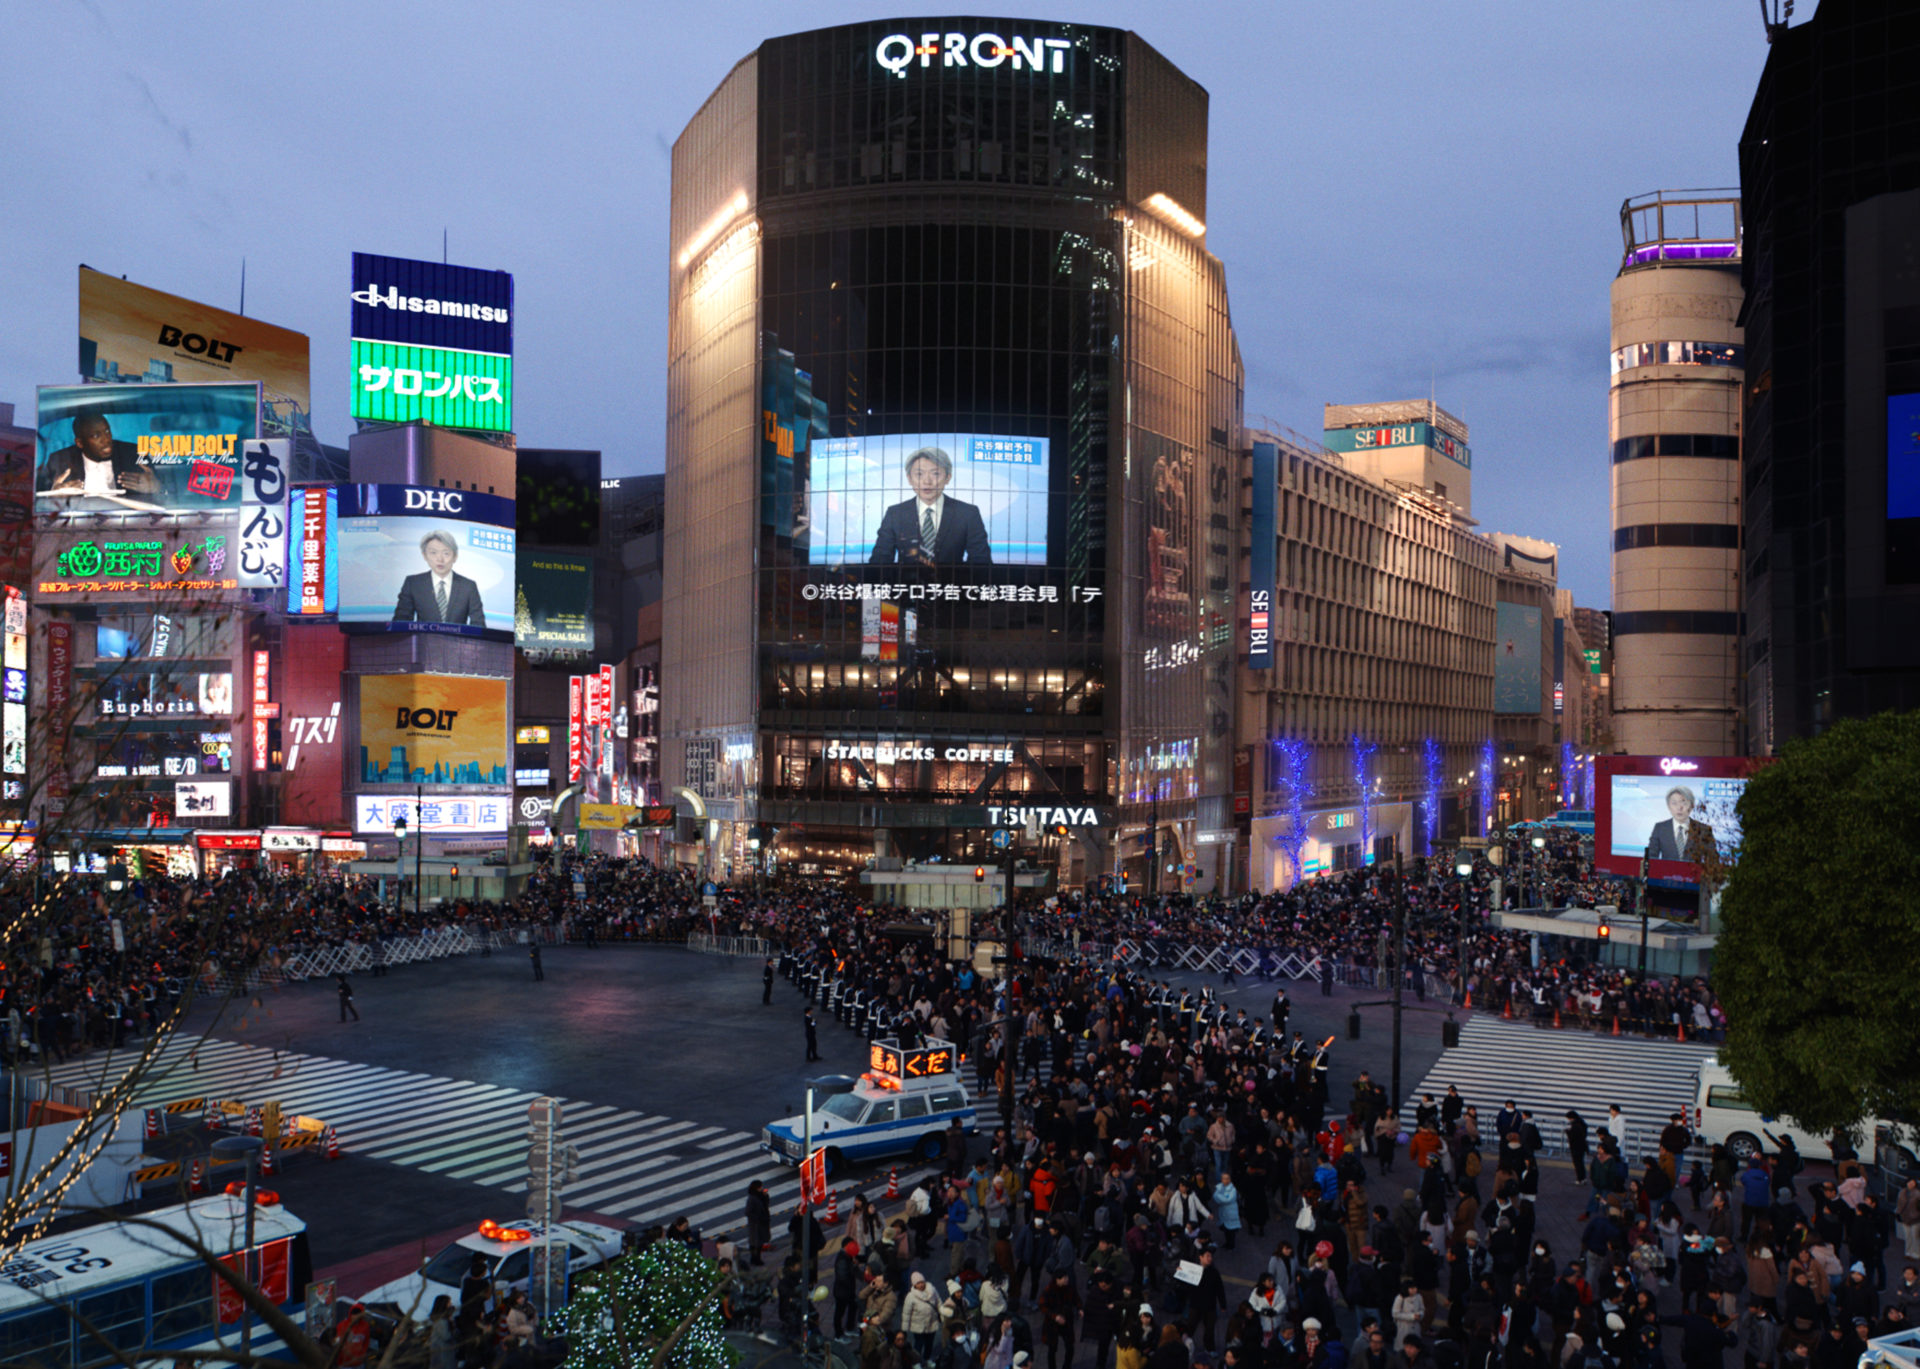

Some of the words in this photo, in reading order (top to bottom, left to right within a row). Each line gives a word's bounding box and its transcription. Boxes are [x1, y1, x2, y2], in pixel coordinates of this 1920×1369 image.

[877, 33, 1070, 78] QFRONT
[351, 284, 508, 323] Hisamitsu
[158, 325, 242, 363] BOLT
[359, 364, 503, 403] サロンパス
[137, 435, 192, 456] USAIN
[194, 434, 237, 455] BOLT
[1355, 427, 1415, 448] SEIBU
[1434, 435, 1468, 466] SEIBU
[192, 475, 228, 495] LATE
[197, 465, 229, 481] NEVER
[241, 442, 285, 584] もんじゃ
[405, 489, 462, 513] DHC
[302, 493, 321, 606] 三千里薬品
[104, 552, 162, 576] 西村
[1251, 590, 1269, 654] SEIBU
[538, 631, 567, 640] SPECIAL
[568, 633, 586, 641] SALE
[102, 699, 194, 717] Euphoria
[396, 707, 458, 731] BOLT
[827, 746, 935, 763] STARBUCKS
[945, 748, 1014, 762] COFFEE
[1660, 758, 1698, 774] Glico
[366, 803, 497, 824] 大盛堂書店
[988, 807, 1098, 825] TSUTAYA
[1327, 812, 1354, 829] SEIBU
[871, 1046, 898, 1074] 進み
